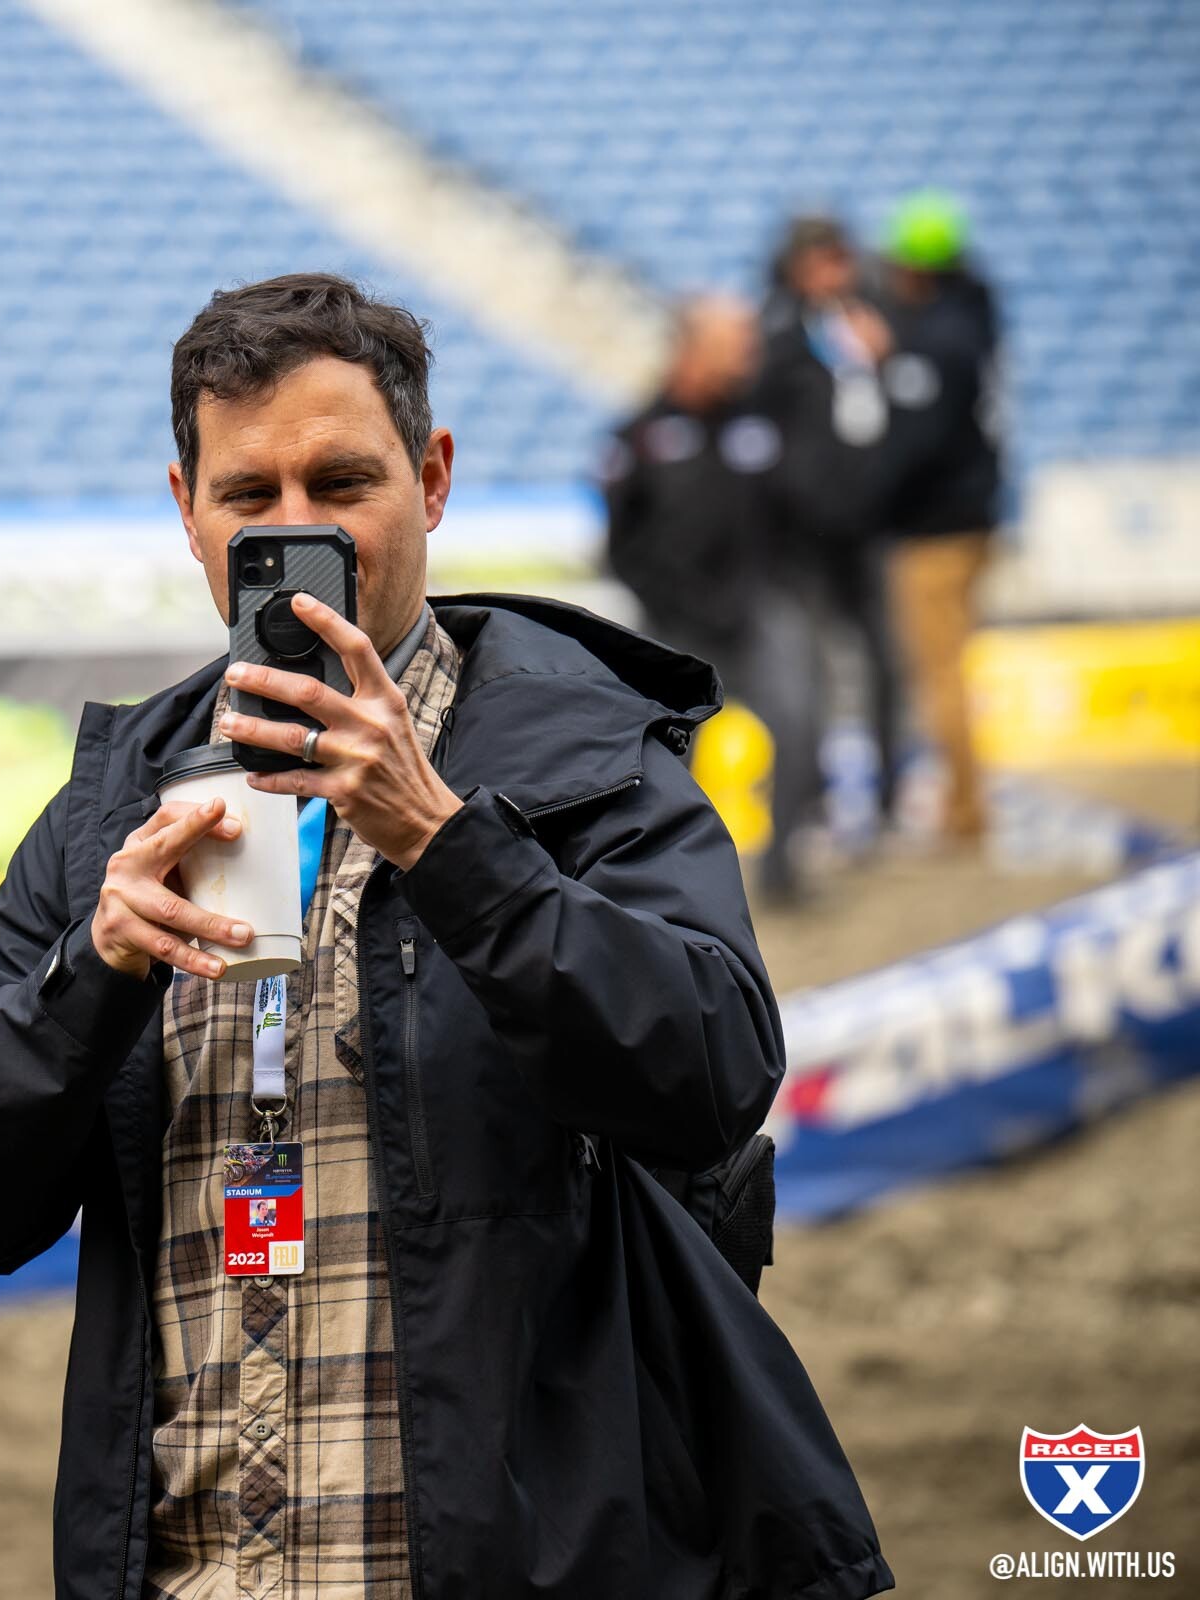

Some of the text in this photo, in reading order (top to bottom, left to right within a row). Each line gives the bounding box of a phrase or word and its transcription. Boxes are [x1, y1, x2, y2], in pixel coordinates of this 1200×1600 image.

[226, 1188, 262, 1197] STADIUM
[228, 1252, 266, 1266] 2022
[273, 1246, 298, 1267] FELD
